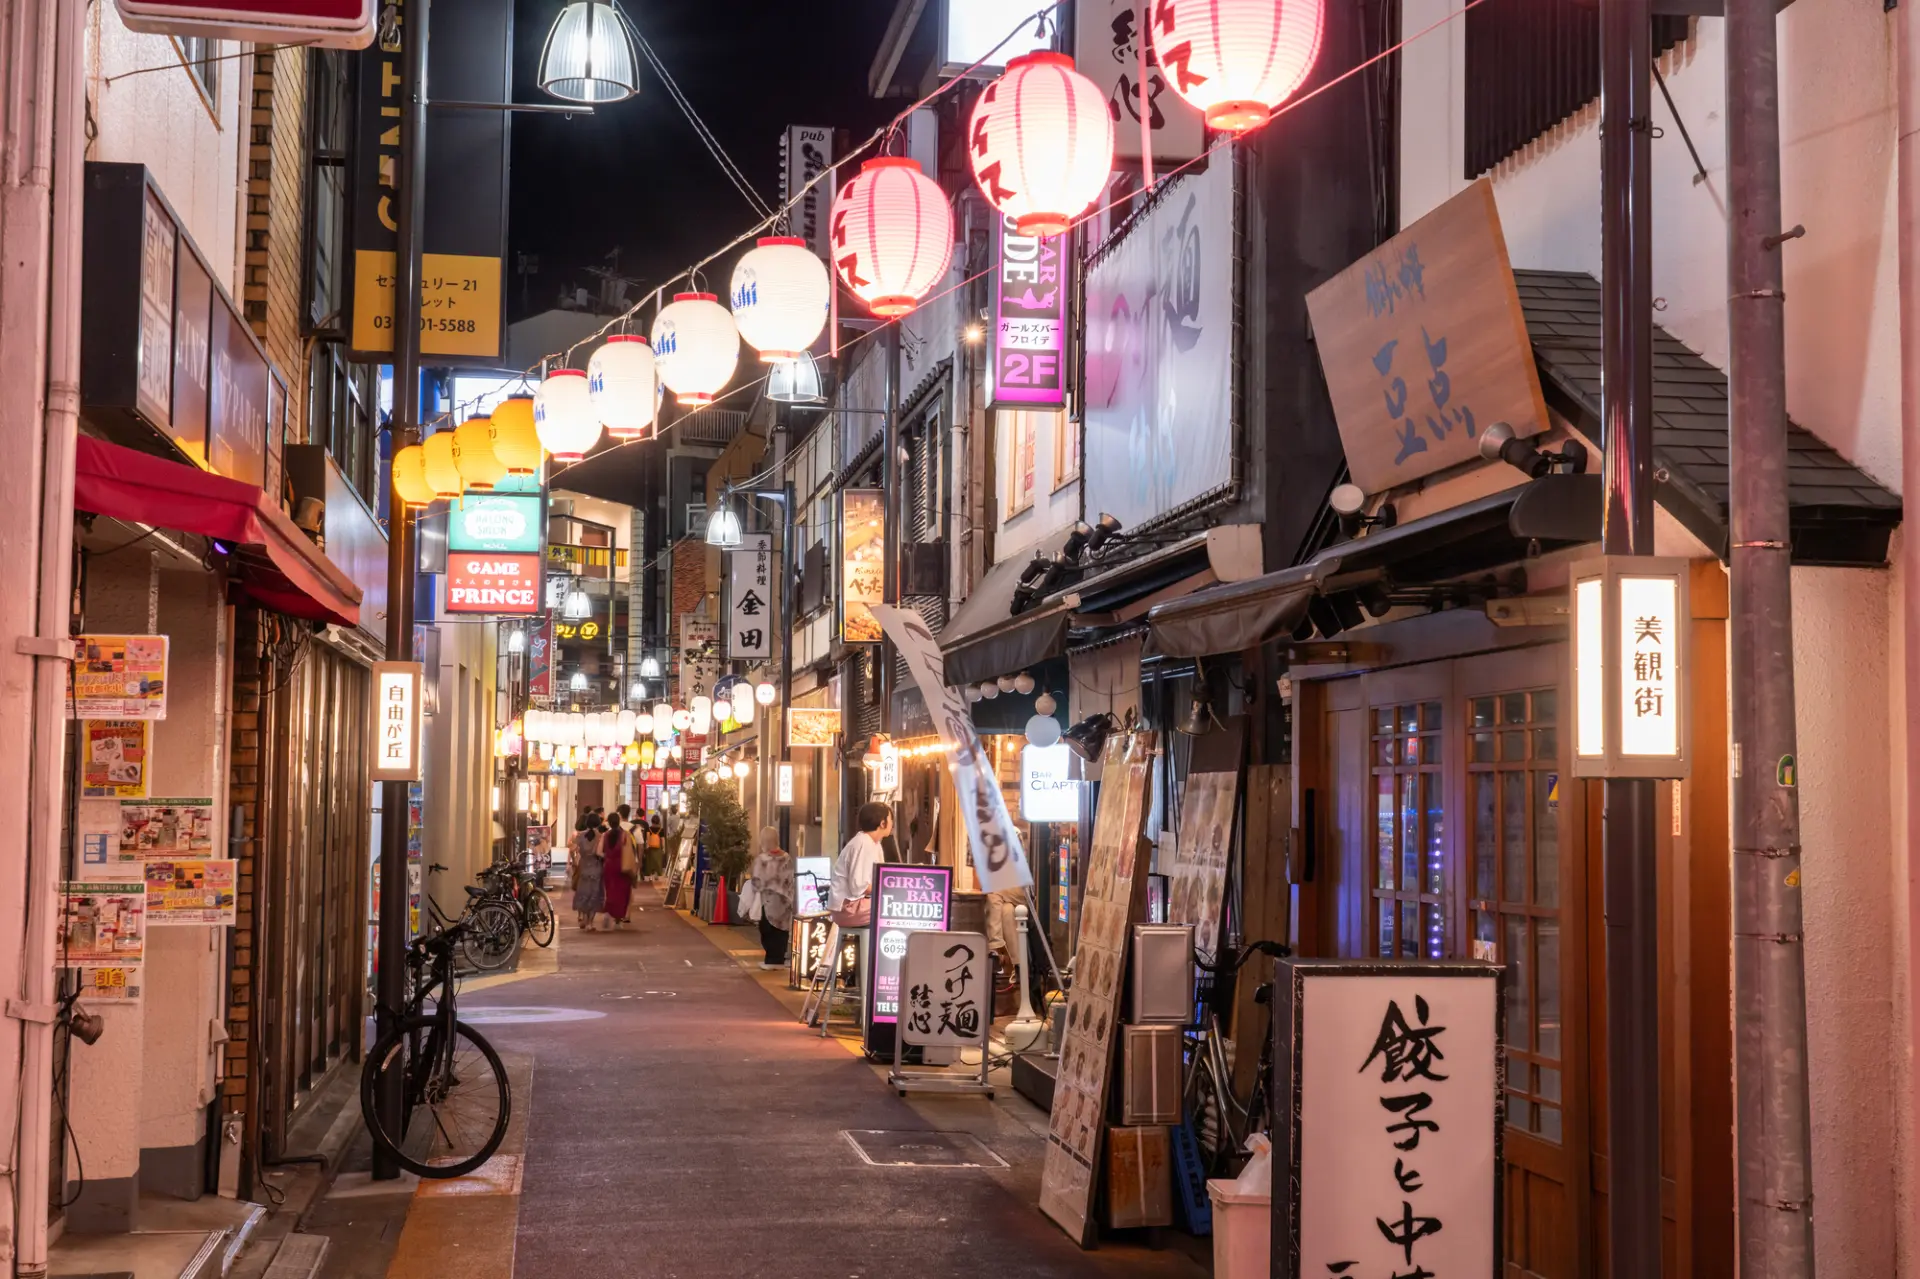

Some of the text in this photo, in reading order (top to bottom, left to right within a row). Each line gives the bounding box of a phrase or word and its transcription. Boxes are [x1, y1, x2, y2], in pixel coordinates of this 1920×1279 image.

[800, 130, 825, 142] pub
[421, 296, 456, 309] レット
[1001, 322, 1060, 334] ガールズバー
[1011, 335, 1050, 346] フロイデ
[1003, 353, 1057, 385] 2F
[467, 561, 520, 575] GAME
[756, 540, 767, 586] 季節料理
[451, 588, 534, 605] PRINCE
[736, 588, 766, 650] 金田
[1634, 615, 1664, 718] 美観街
[387, 685, 404, 758] 自由が丘
[883, 875, 935, 890] GIRL'S
[882, 895, 943, 919] FREUDE
[907, 890, 943, 903] BAR
[937, 944, 980, 1039] つけ麺
[908, 984, 934, 1034] 結心
[1358, 994, 1449, 1279] 餃子と中
